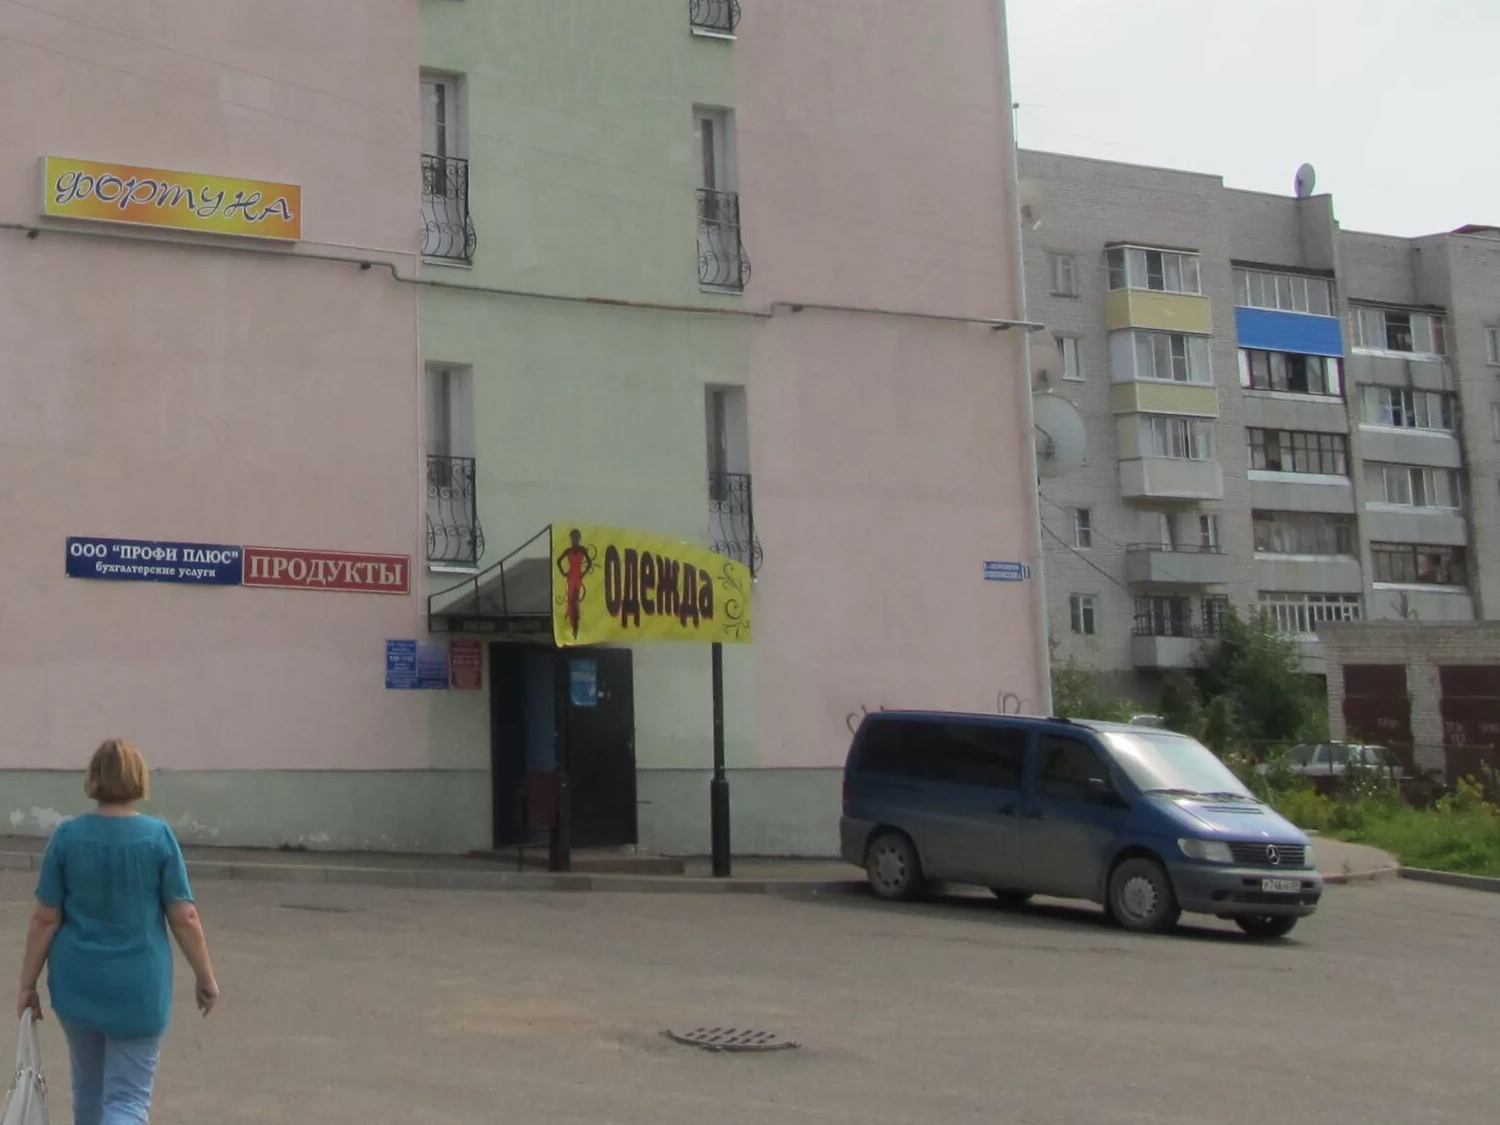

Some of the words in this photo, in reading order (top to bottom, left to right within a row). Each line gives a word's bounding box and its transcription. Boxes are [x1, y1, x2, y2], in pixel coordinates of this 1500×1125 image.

[70, 542, 108, 558] ООО
[95, 561, 176, 576] бухгалтерские
[179, 567, 216, 579] услуги
[250, 555, 403, 586] ПРОДУКТЫ
